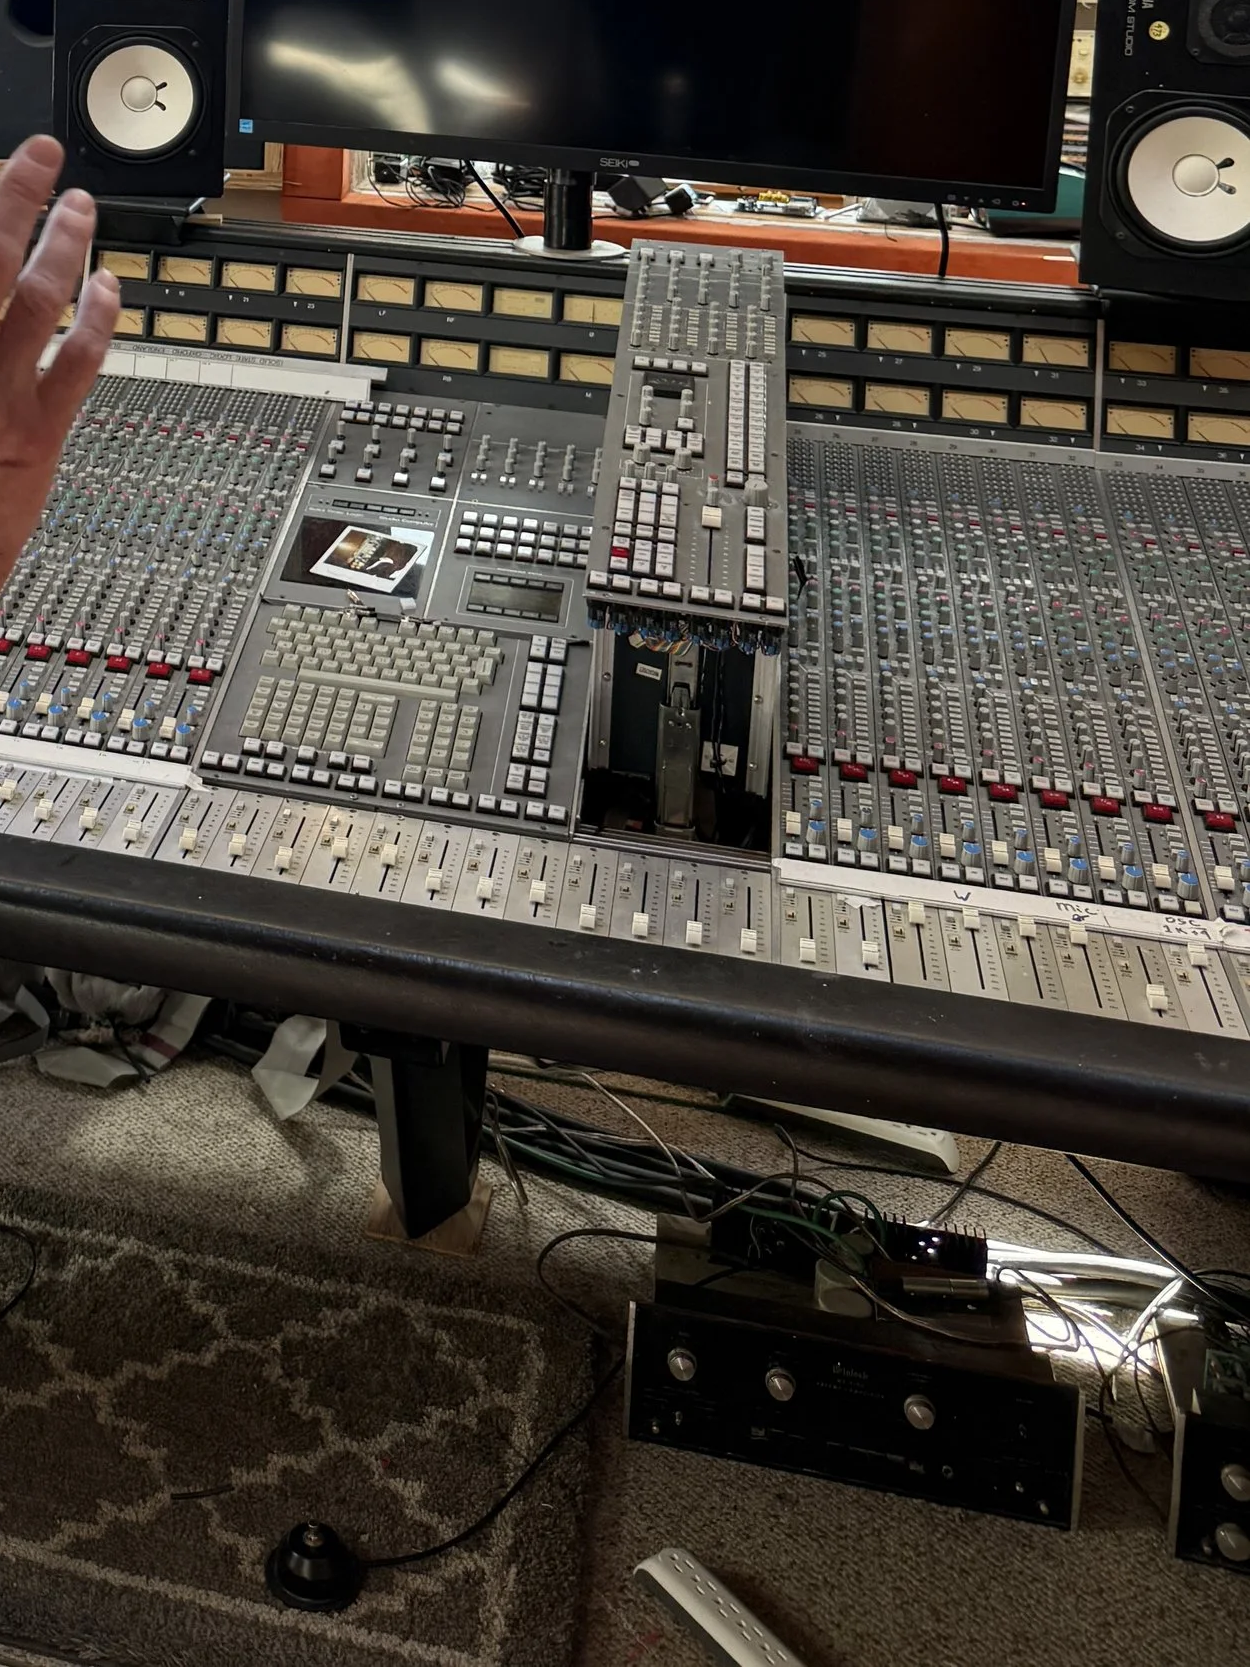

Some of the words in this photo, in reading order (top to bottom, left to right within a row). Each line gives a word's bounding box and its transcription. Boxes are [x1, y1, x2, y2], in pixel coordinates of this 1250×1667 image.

[1124, 16, 1135, 56] STUDIO
[1152, 23, 1163, 38] 473
[600, 157, 628, 169] SEIKI
[210, 352, 233, 361] LOGIC
